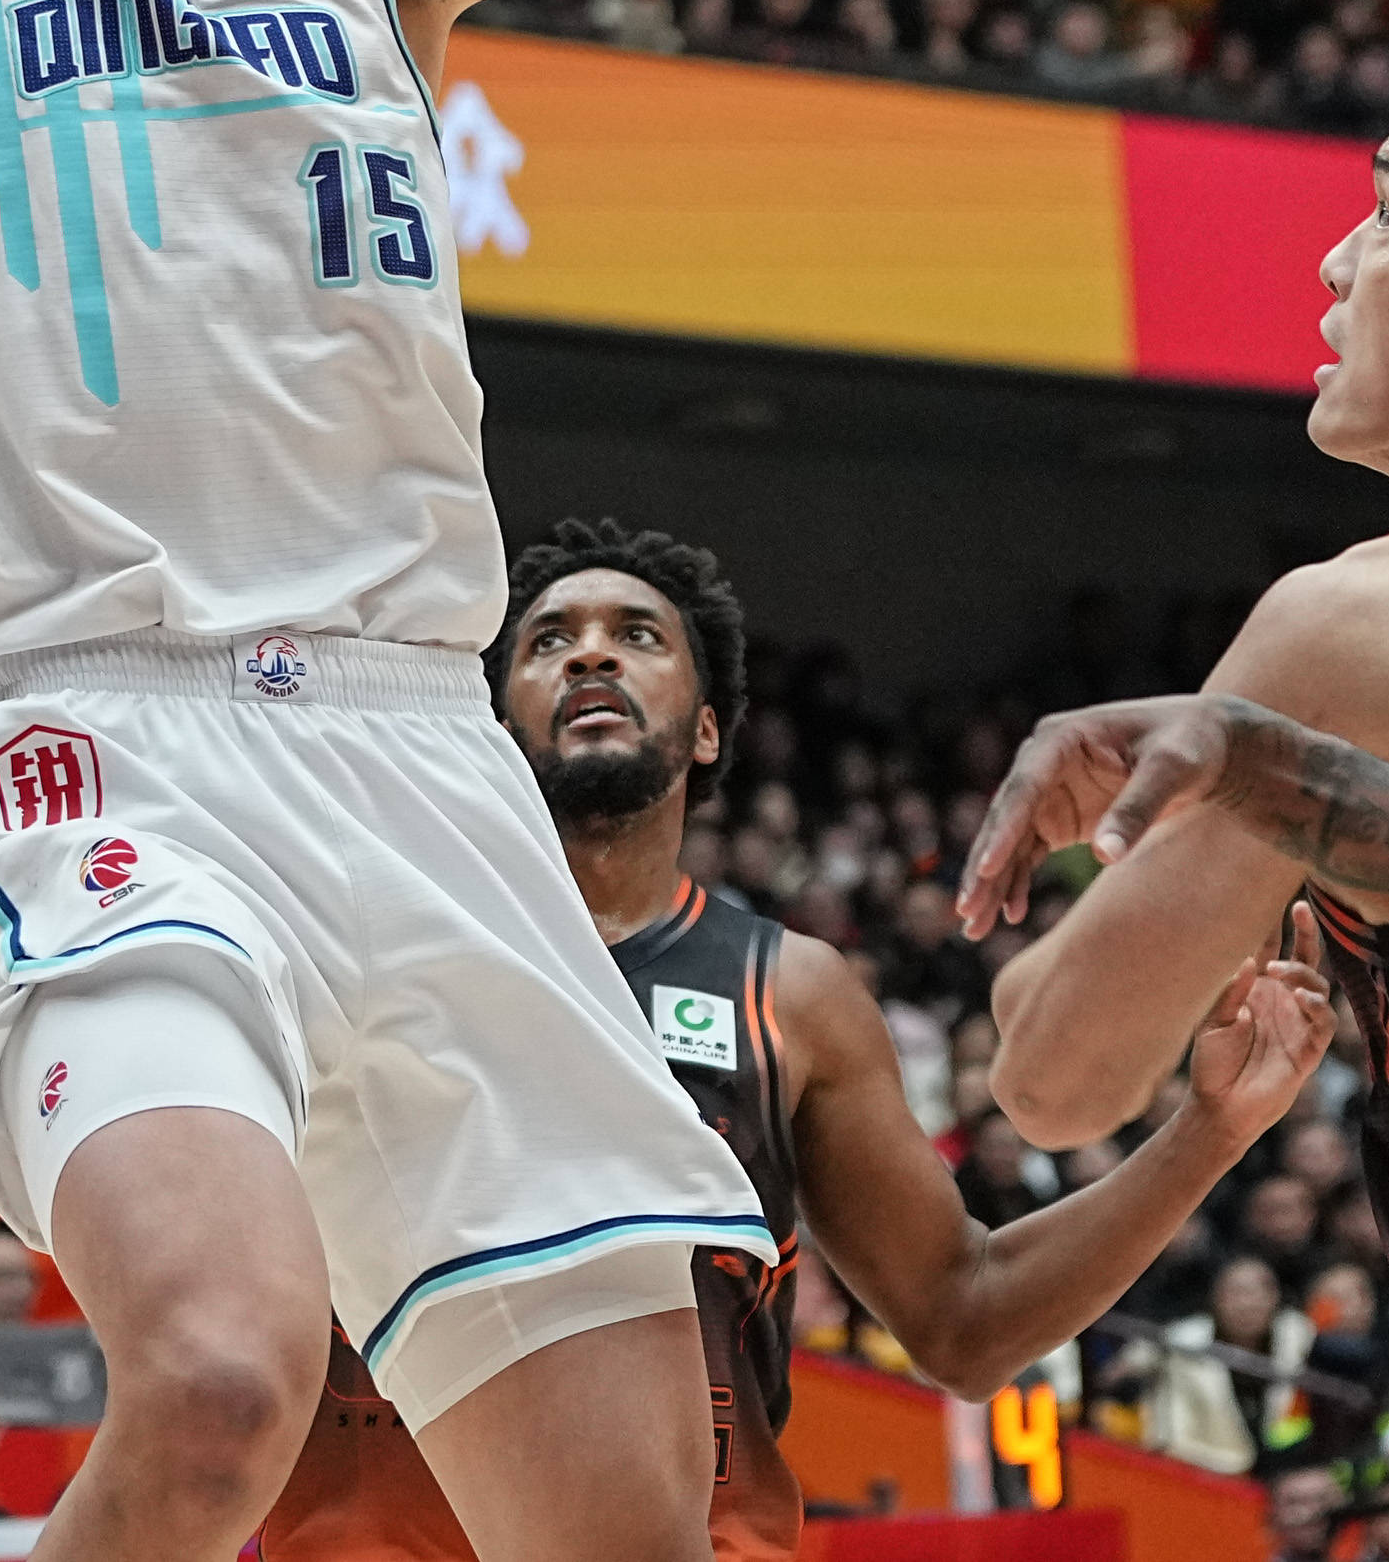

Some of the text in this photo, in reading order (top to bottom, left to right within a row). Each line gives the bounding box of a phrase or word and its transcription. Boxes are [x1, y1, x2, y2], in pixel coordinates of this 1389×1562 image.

[298, 141, 439, 290] 15
[254, 678, 300, 698] QINGDAO
[10, 741, 84, 830] 锐
[98, 882, 147, 909] CBA
[662, 1033, 729, 1052] 中国人寿
[662, 1045, 728, 1061] CHINA LIFE
[992, 1382, 1062, 1511] 4
